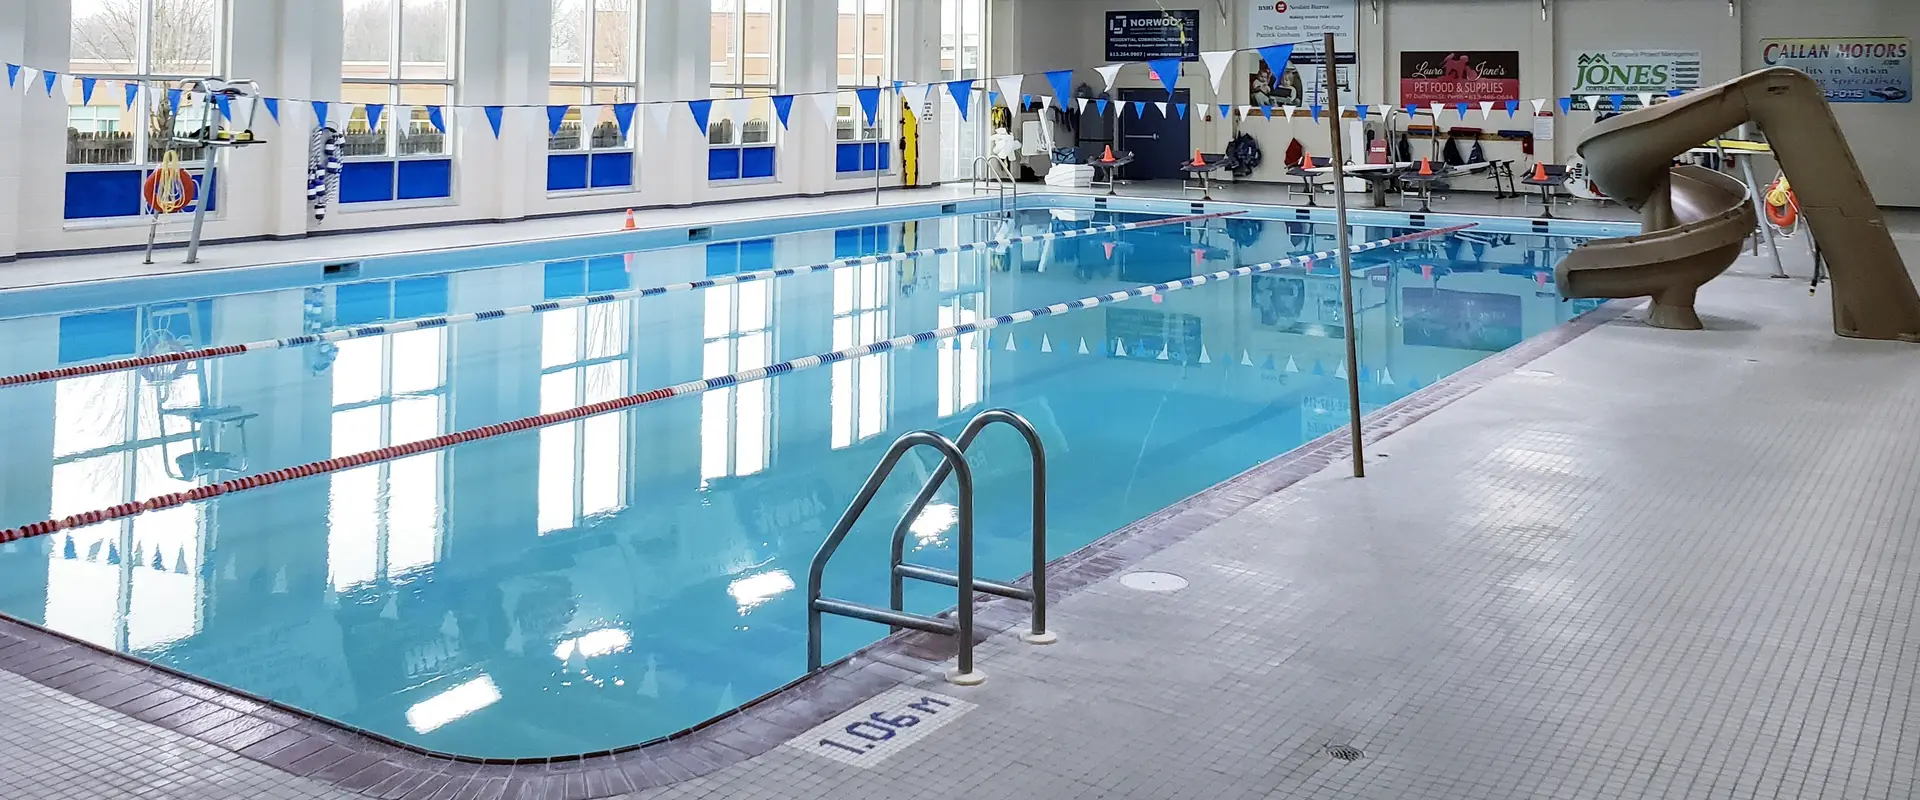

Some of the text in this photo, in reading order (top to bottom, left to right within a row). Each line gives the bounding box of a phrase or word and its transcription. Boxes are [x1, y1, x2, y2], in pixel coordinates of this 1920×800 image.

[1130, 18, 1182, 27] NORWOO
[1763, 43, 1907, 65] CALLAN MOTORS
[1412, 61, 1505, 81] Laura Jane's
[1572, 65, 1668, 90] JONES
[1830, 66, 1842, 75] in
[1846, 66, 1888, 75] Motion
[1414, 82, 1503, 93] PET FOOD & SUPPLIES
[819, 696, 951, 755] 1.06 M
